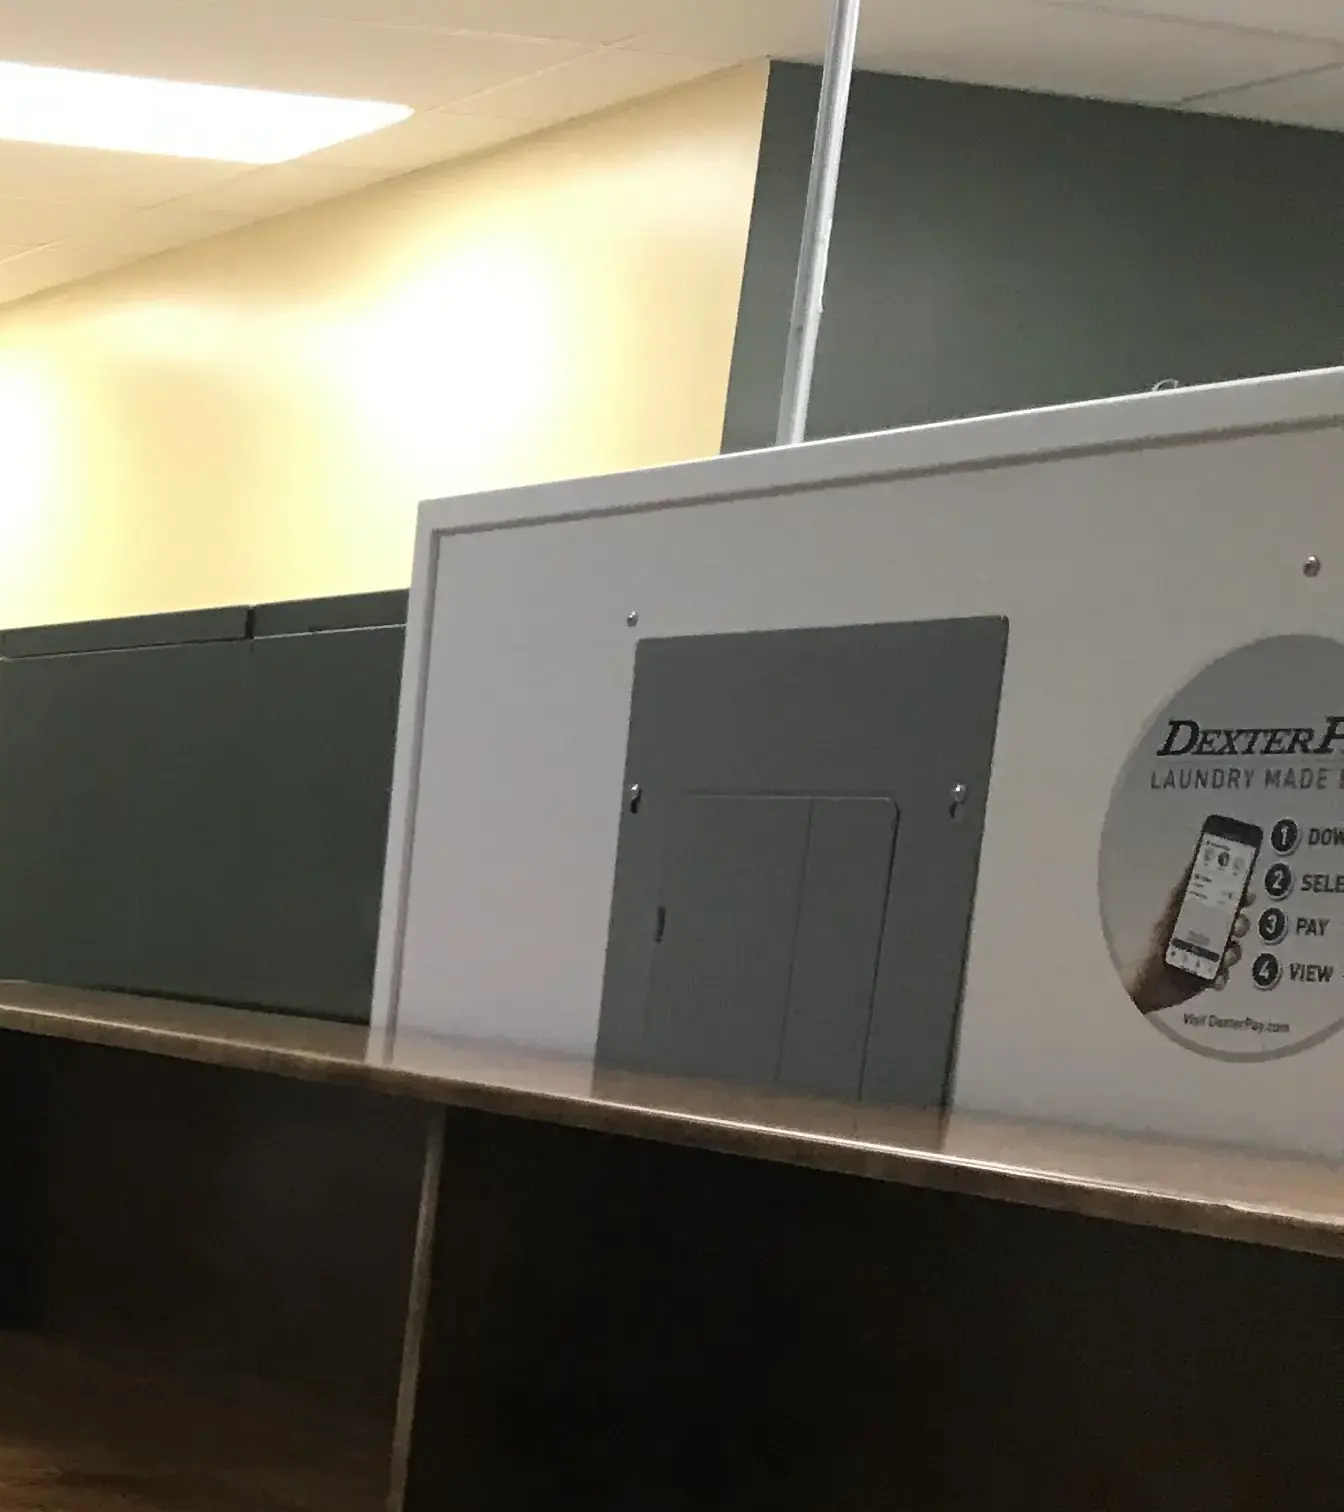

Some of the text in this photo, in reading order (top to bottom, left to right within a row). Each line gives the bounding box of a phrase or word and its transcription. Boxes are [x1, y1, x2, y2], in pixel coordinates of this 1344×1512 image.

[1150, 768, 1256, 790] LAUNDRY
[1264, 768, 1331, 790] MADE
[1296, 917, 1331, 936] PAY
[1289, 962, 1334, 983] VIEW
